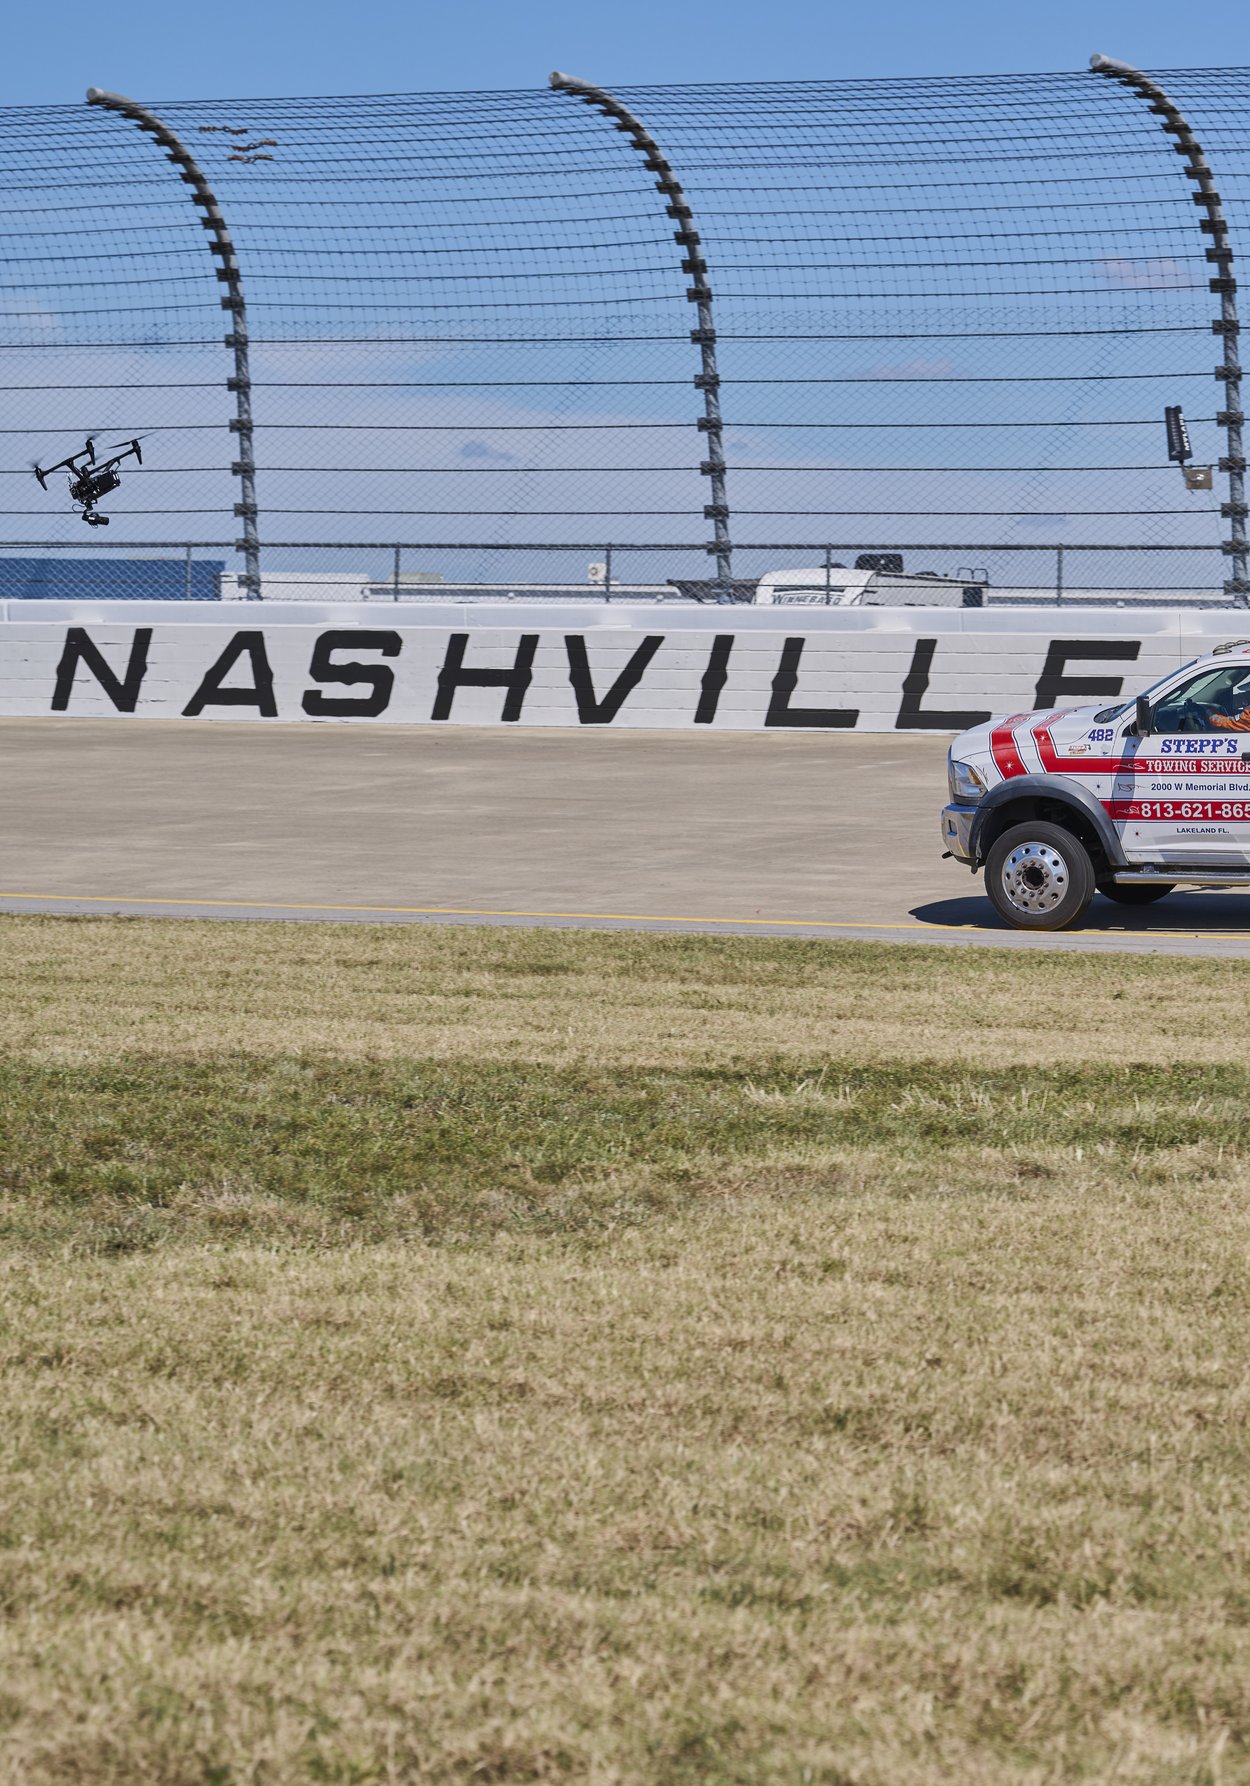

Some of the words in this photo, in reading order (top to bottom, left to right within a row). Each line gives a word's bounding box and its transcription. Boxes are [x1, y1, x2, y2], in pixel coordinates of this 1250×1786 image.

[51, 627, 1141, 729] NASHVILLE
[1088, 728, 1114, 742] 482
[1160, 737, 1238, 754] STEPP'S
[1146, 760, 1197, 773] TOWING
[1151, 783, 1172, 791] 2000
[1174, 783, 1183, 791] W
[1185, 783, 1227, 791] Memorial
